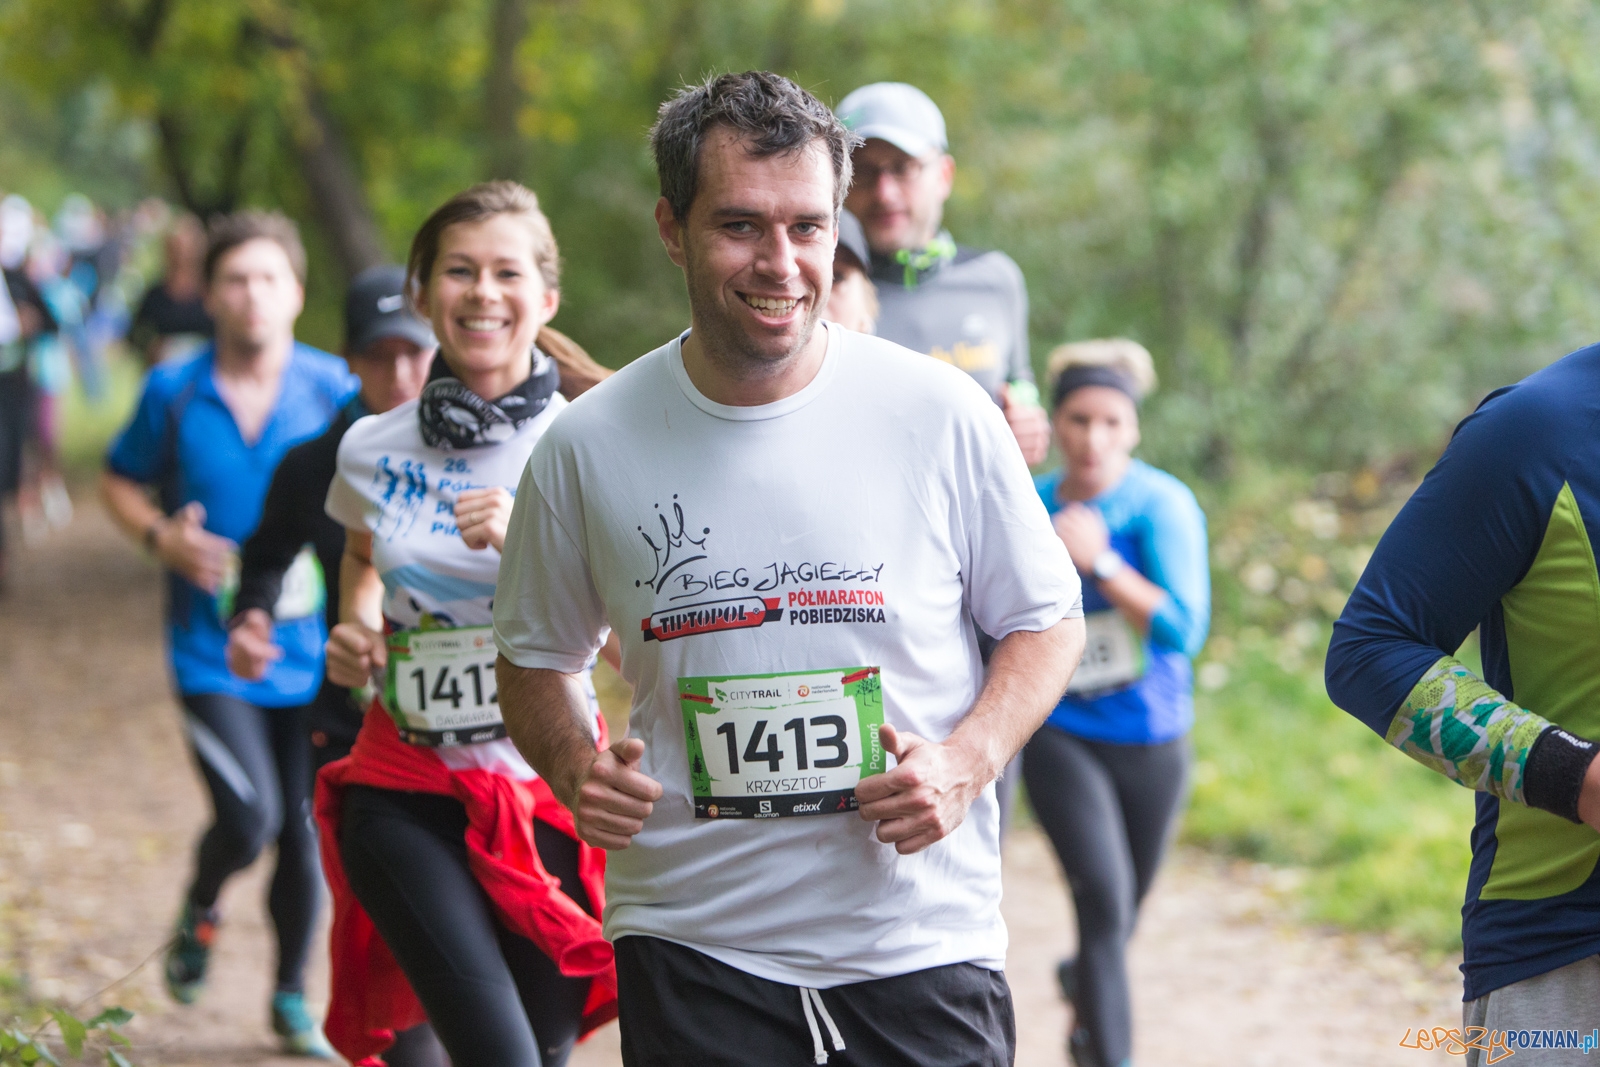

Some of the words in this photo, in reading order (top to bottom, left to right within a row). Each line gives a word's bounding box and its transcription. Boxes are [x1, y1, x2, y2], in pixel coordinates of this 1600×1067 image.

[444, 458, 472, 473] 26.
[669, 568, 749, 601] BIEG
[753, 562, 884, 591] JAGIEŁŁY
[788, 588, 884, 607] PÓŁMARATON
[660, 605, 747, 633] TIPTOPOL
[790, 607, 886, 625] POBIEDZISKA
[717, 714, 849, 774] 1413
[867, 723, 880, 770] Poznań
[746, 776, 827, 793] KRZYSZTOF
